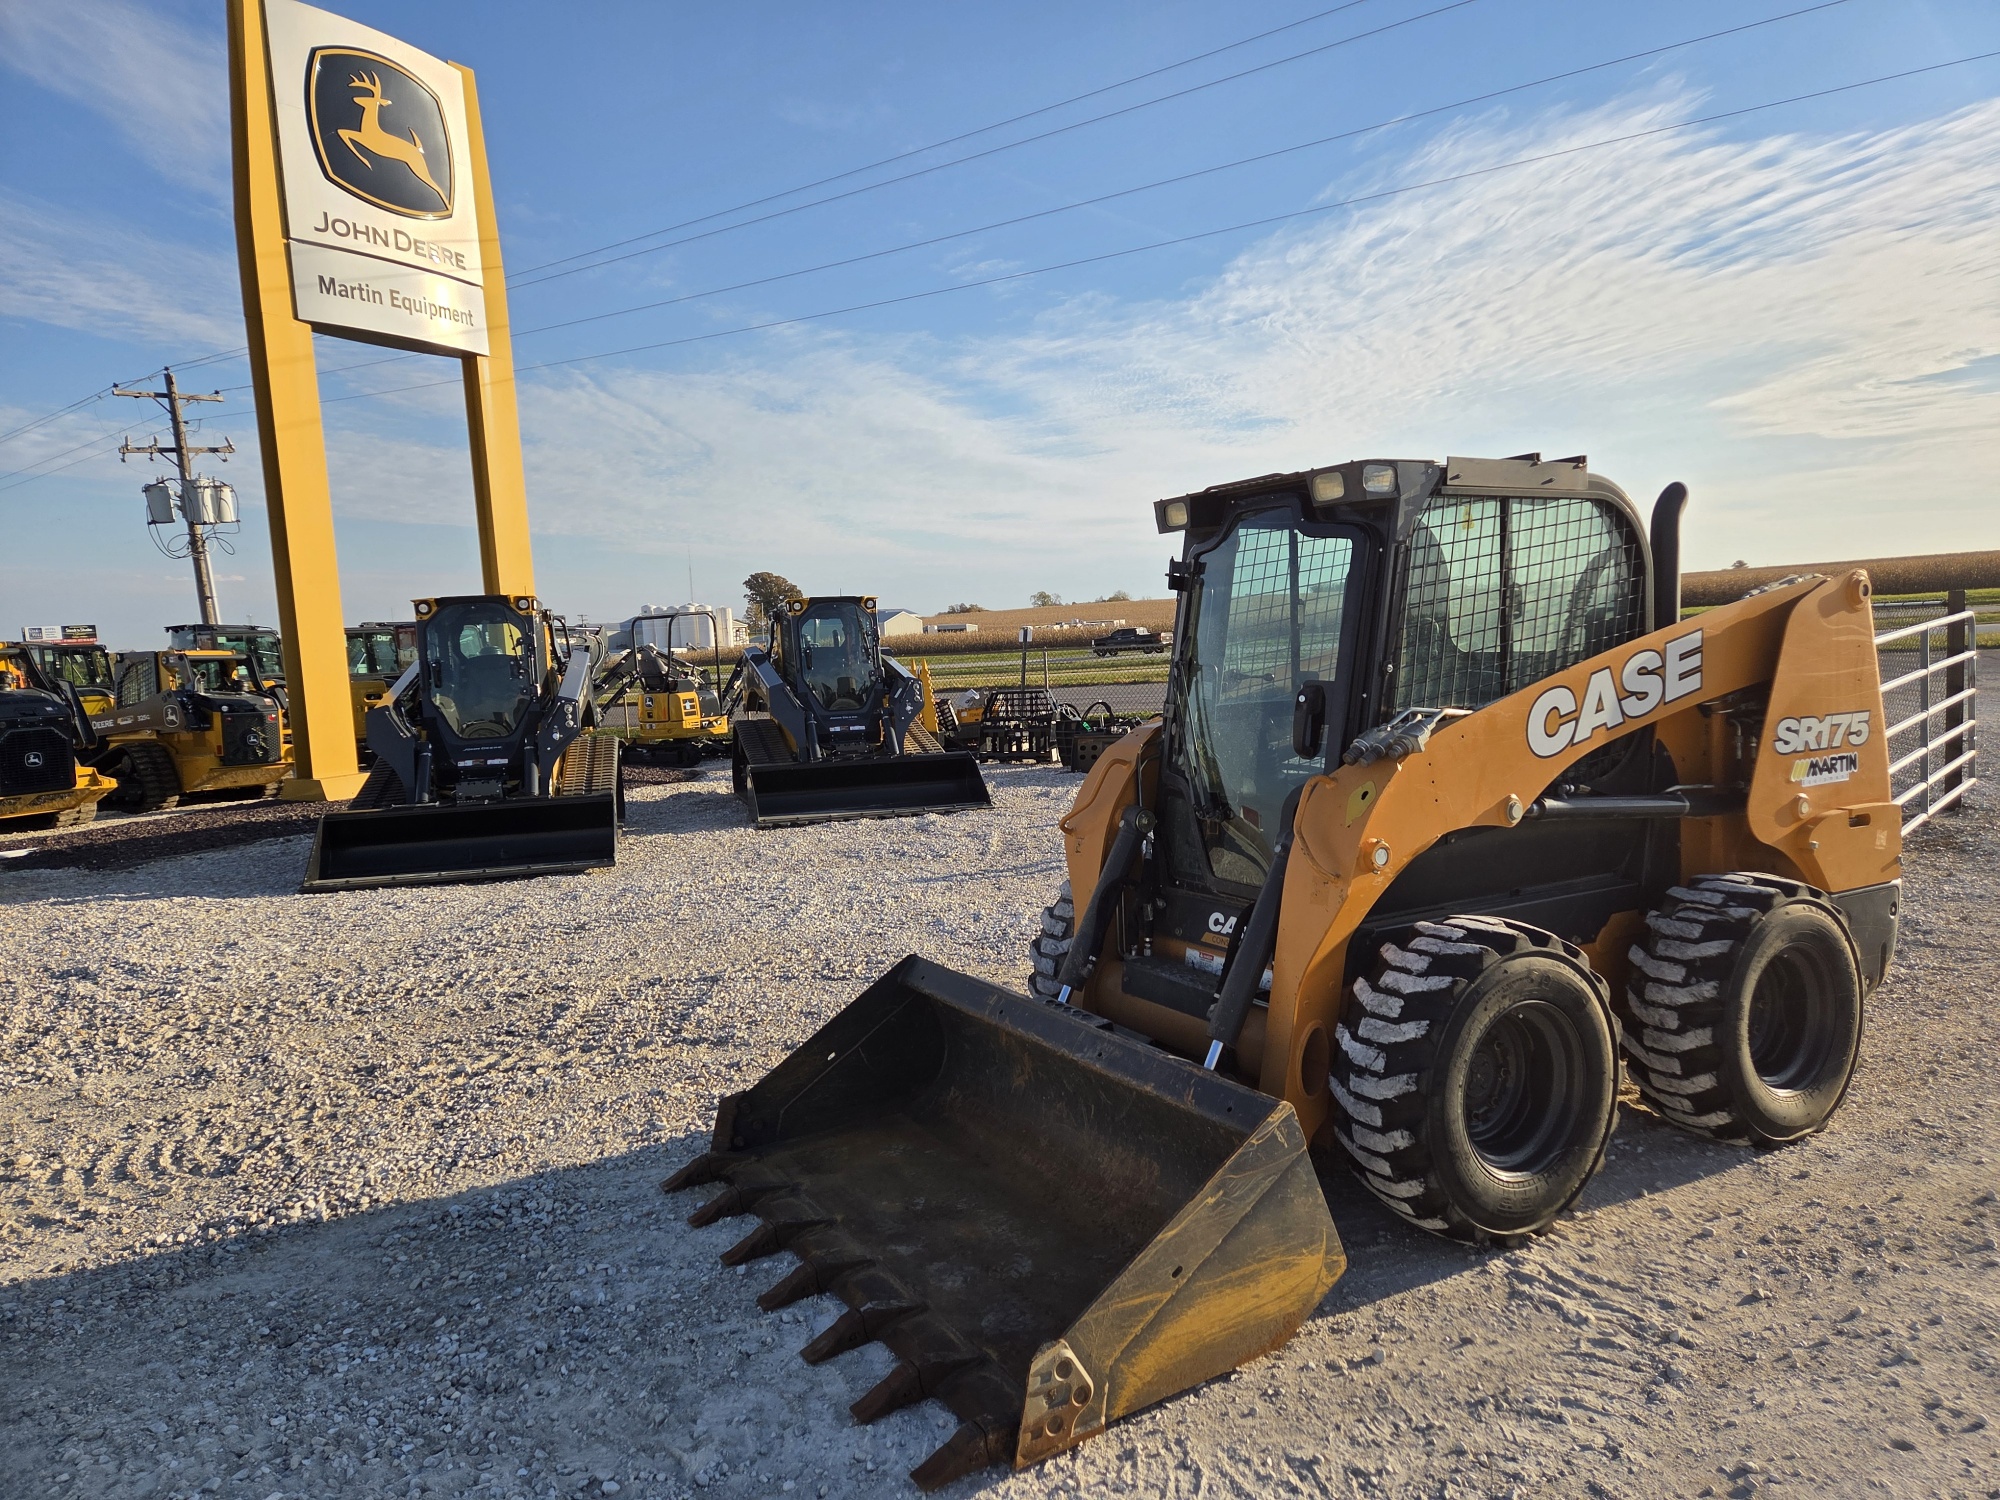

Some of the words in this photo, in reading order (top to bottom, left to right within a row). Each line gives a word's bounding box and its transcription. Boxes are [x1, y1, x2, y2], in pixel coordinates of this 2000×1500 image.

[313, 211, 390, 248] JOHN
[393, 228, 467, 270] DEERE
[317, 274, 383, 305] Martin
[389, 288, 474, 327] Equipment
[1526, 627, 1704, 760] CASE
[91, 719, 115, 730] DEERE
[1773, 709, 1871, 756] SR175
[1806, 752, 1857, 778] MARTIN
